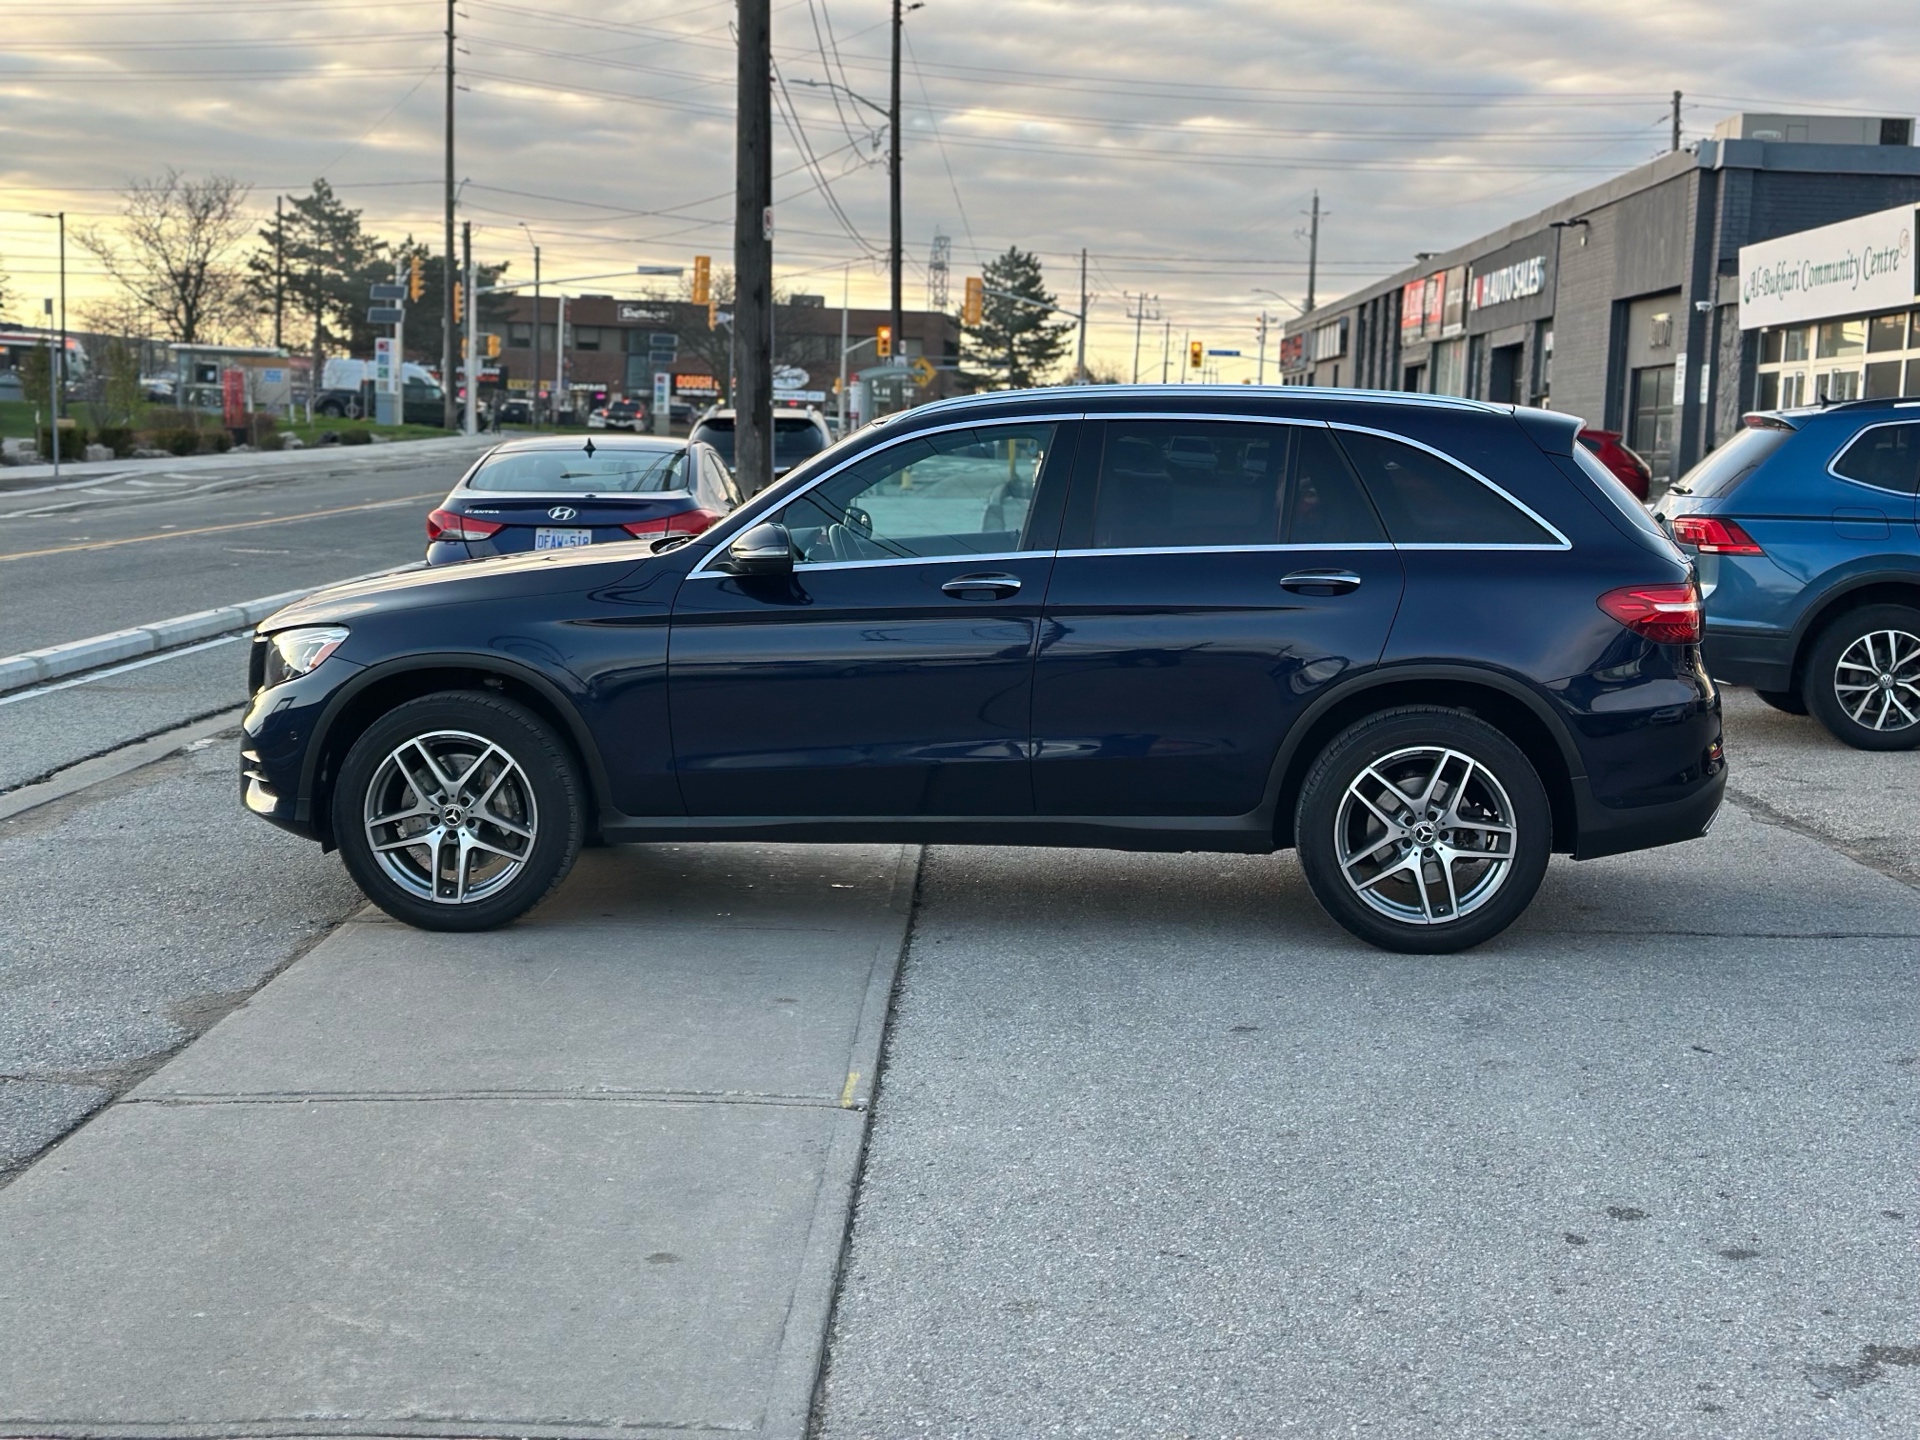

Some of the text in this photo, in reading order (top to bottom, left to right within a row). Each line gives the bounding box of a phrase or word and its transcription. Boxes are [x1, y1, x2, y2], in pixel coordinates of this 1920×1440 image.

[1490, 266, 1513, 305] AUTO
[1513, 256, 1546, 300] SALES
[1749, 245, 1900, 300] Al-Bukhari Community Centre
[676, 374, 713, 389] DOUGH
